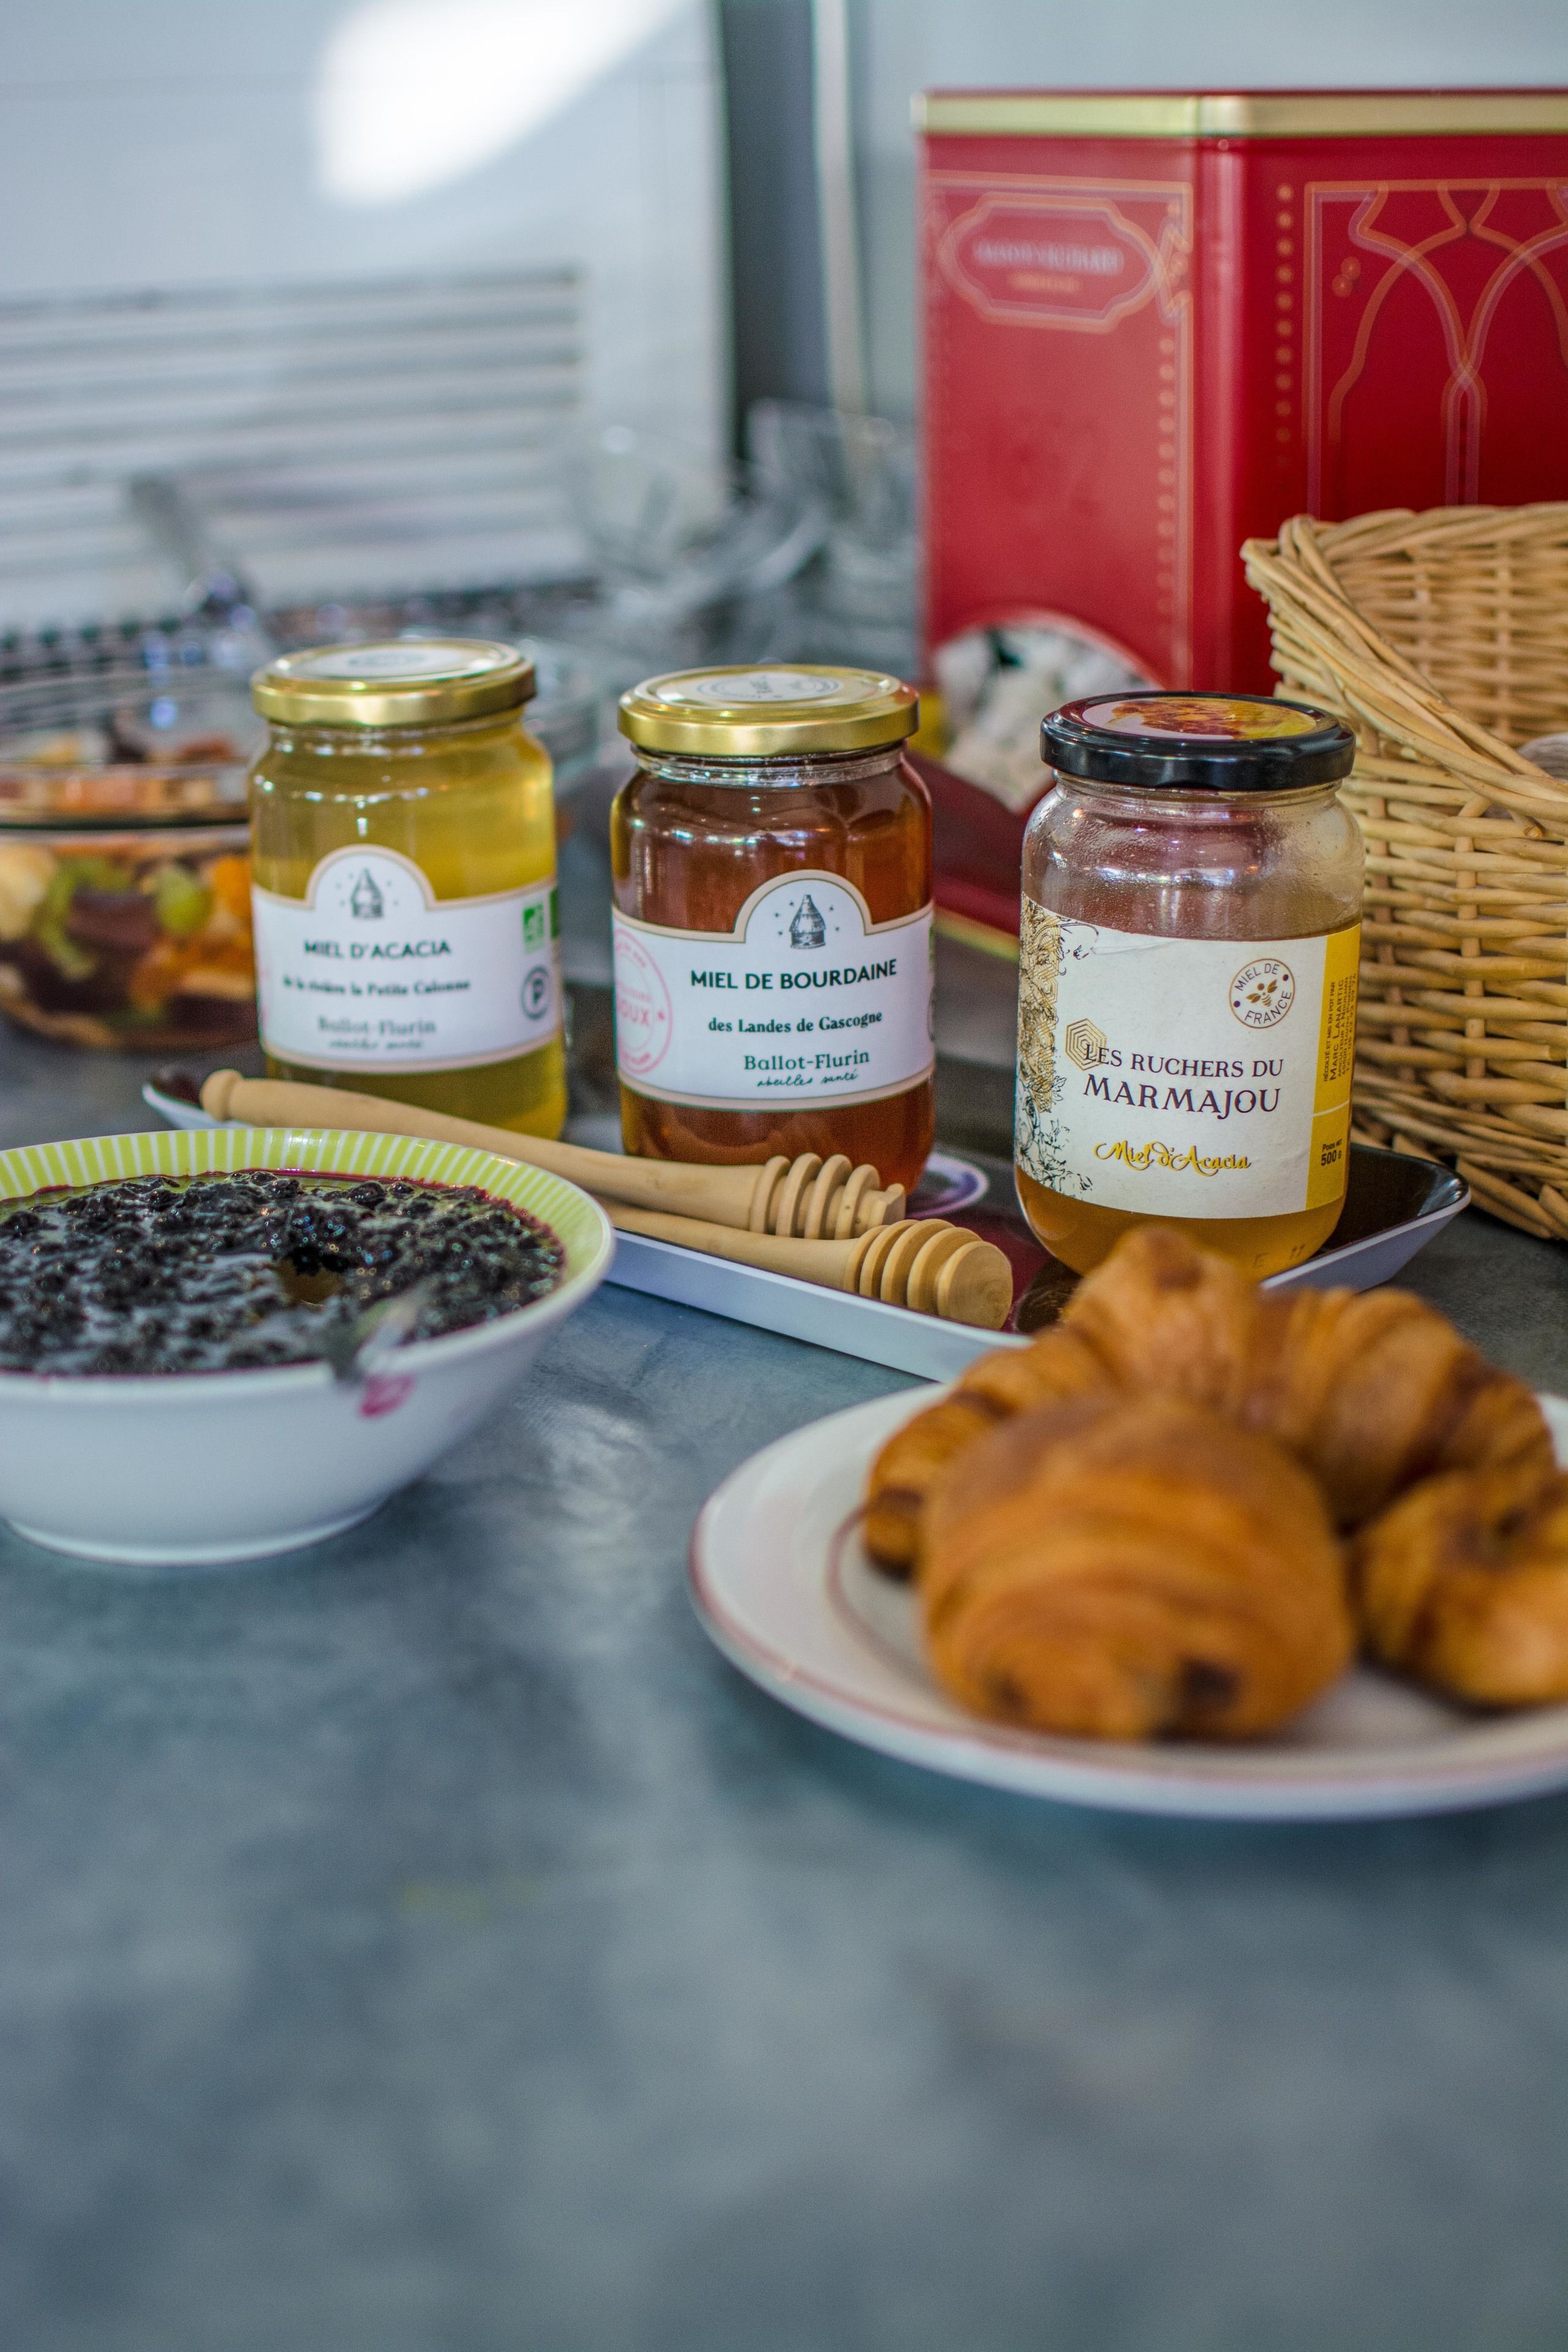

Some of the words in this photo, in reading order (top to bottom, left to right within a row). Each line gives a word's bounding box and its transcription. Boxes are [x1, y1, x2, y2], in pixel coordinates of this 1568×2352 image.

[305, 939, 344, 958] MIEL
[350, 940, 451, 959] D'ACACIA
[691, 970, 738, 989] MIEL
[745, 973, 773, 990] DE
[780, 959, 897, 990] BOURDAINE
[1234, 967, 1261, 991] MIEL
[1264, 963, 1280, 975] DE
[1245, 991, 1292, 1024] FRANCE
[1328, 1014, 1333, 1024] EN
[709, 1017, 733, 1032] des
[739, 1019, 791, 1033] Landes
[796, 1018, 813, 1032] de
[818, 1012, 882, 1031] Gascogne
[744, 1050, 870, 1071] Ballot-Flurin
[1085, 1044, 1123, 1067] LES
[1130, 1053, 1244, 1078] RUCHERS
[1251, 1059, 1284, 1077] DU
[821, 1069, 859, 1085] santé
[1082, 1073, 1281, 1120] MARMAJOU
[1093, 1140, 1153, 1171] Miel
[1150, 1141, 1251, 1177] d'Acacia
[1321, 1150, 1336, 1166] 500
